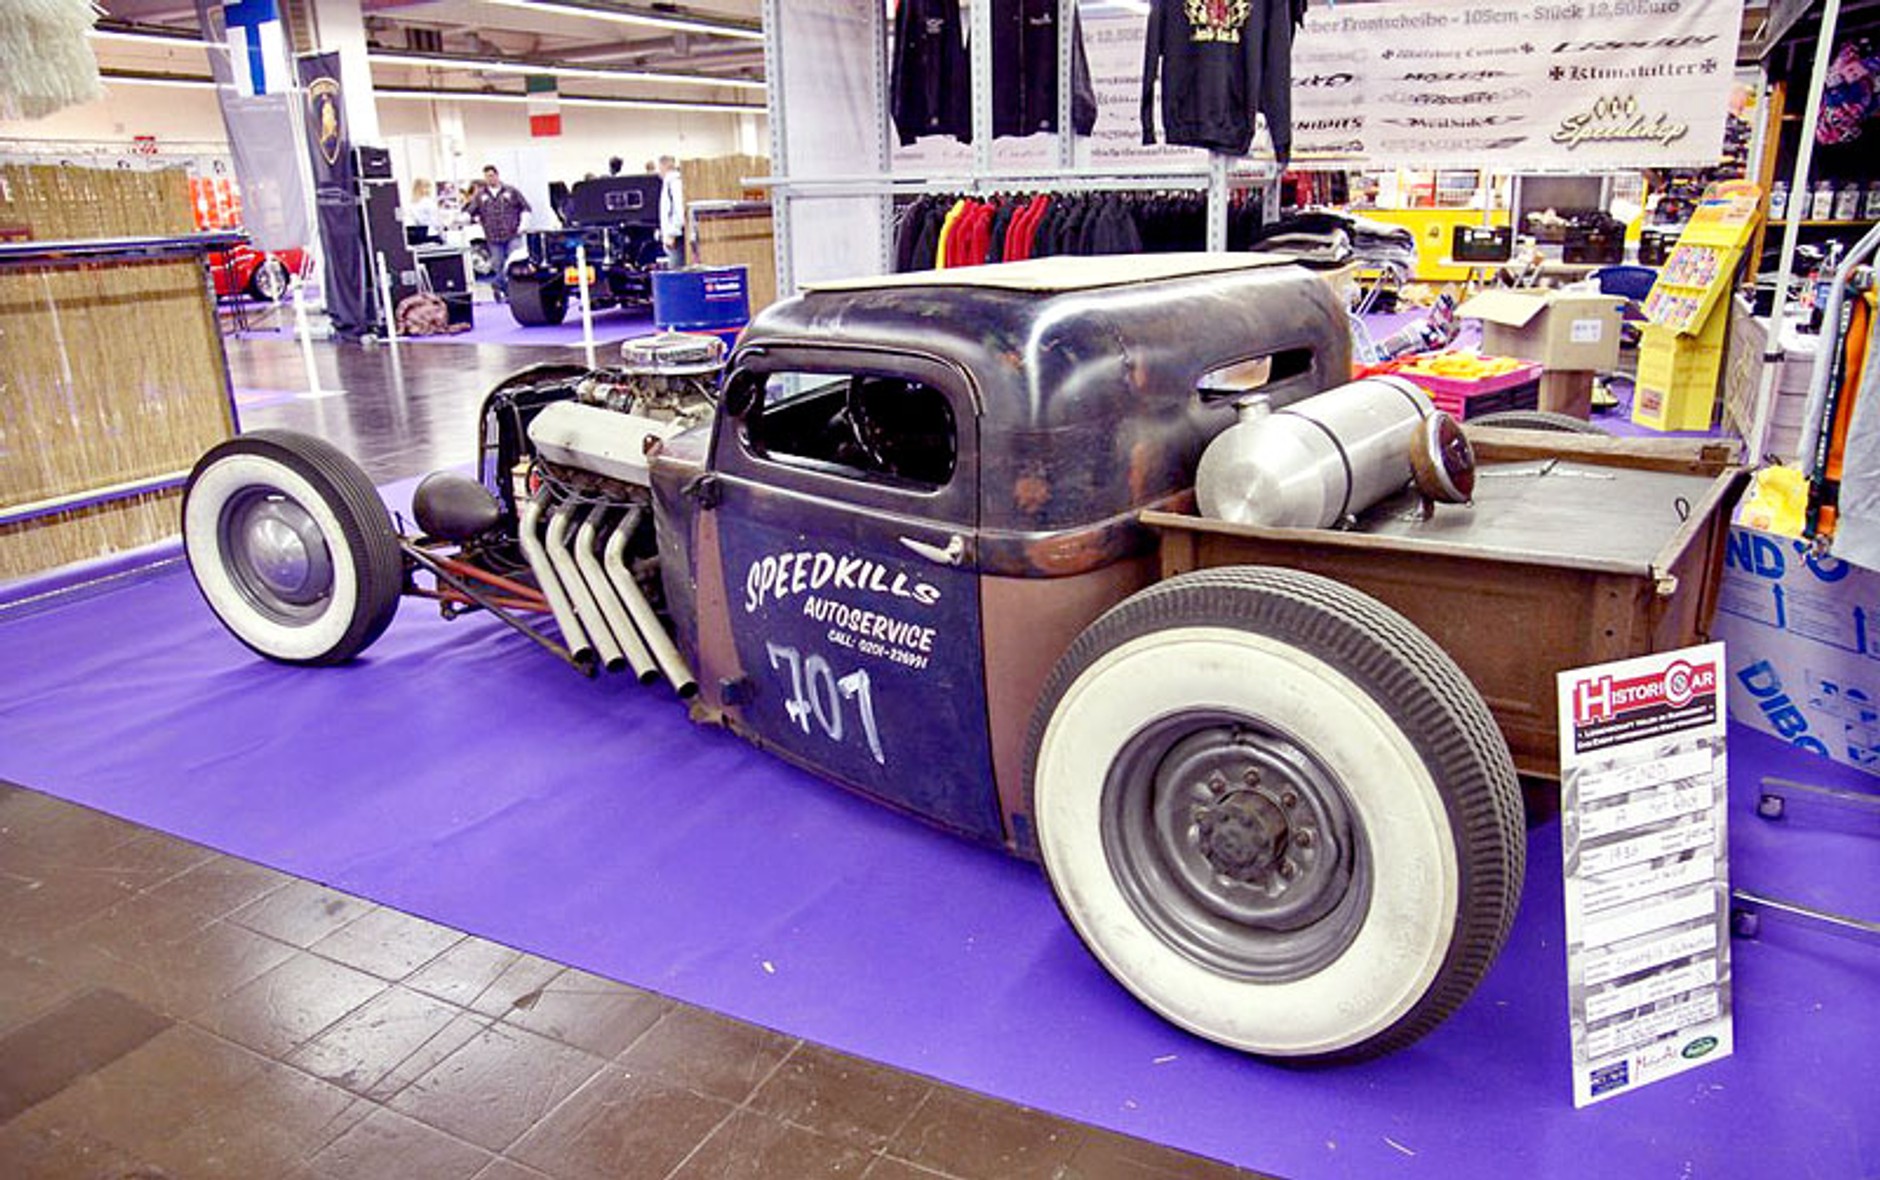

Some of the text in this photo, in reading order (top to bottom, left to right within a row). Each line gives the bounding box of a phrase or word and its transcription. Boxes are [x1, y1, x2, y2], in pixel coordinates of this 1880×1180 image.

[1342, 12, 1448, 32] Frontscheibe
[1463, 8, 1519, 26] 105cm
[1534, 4, 1584, 21] Stück
[745, 552, 941, 613] SPEEDKILLS
[803, 596, 936, 652] AUTOSERVICE
